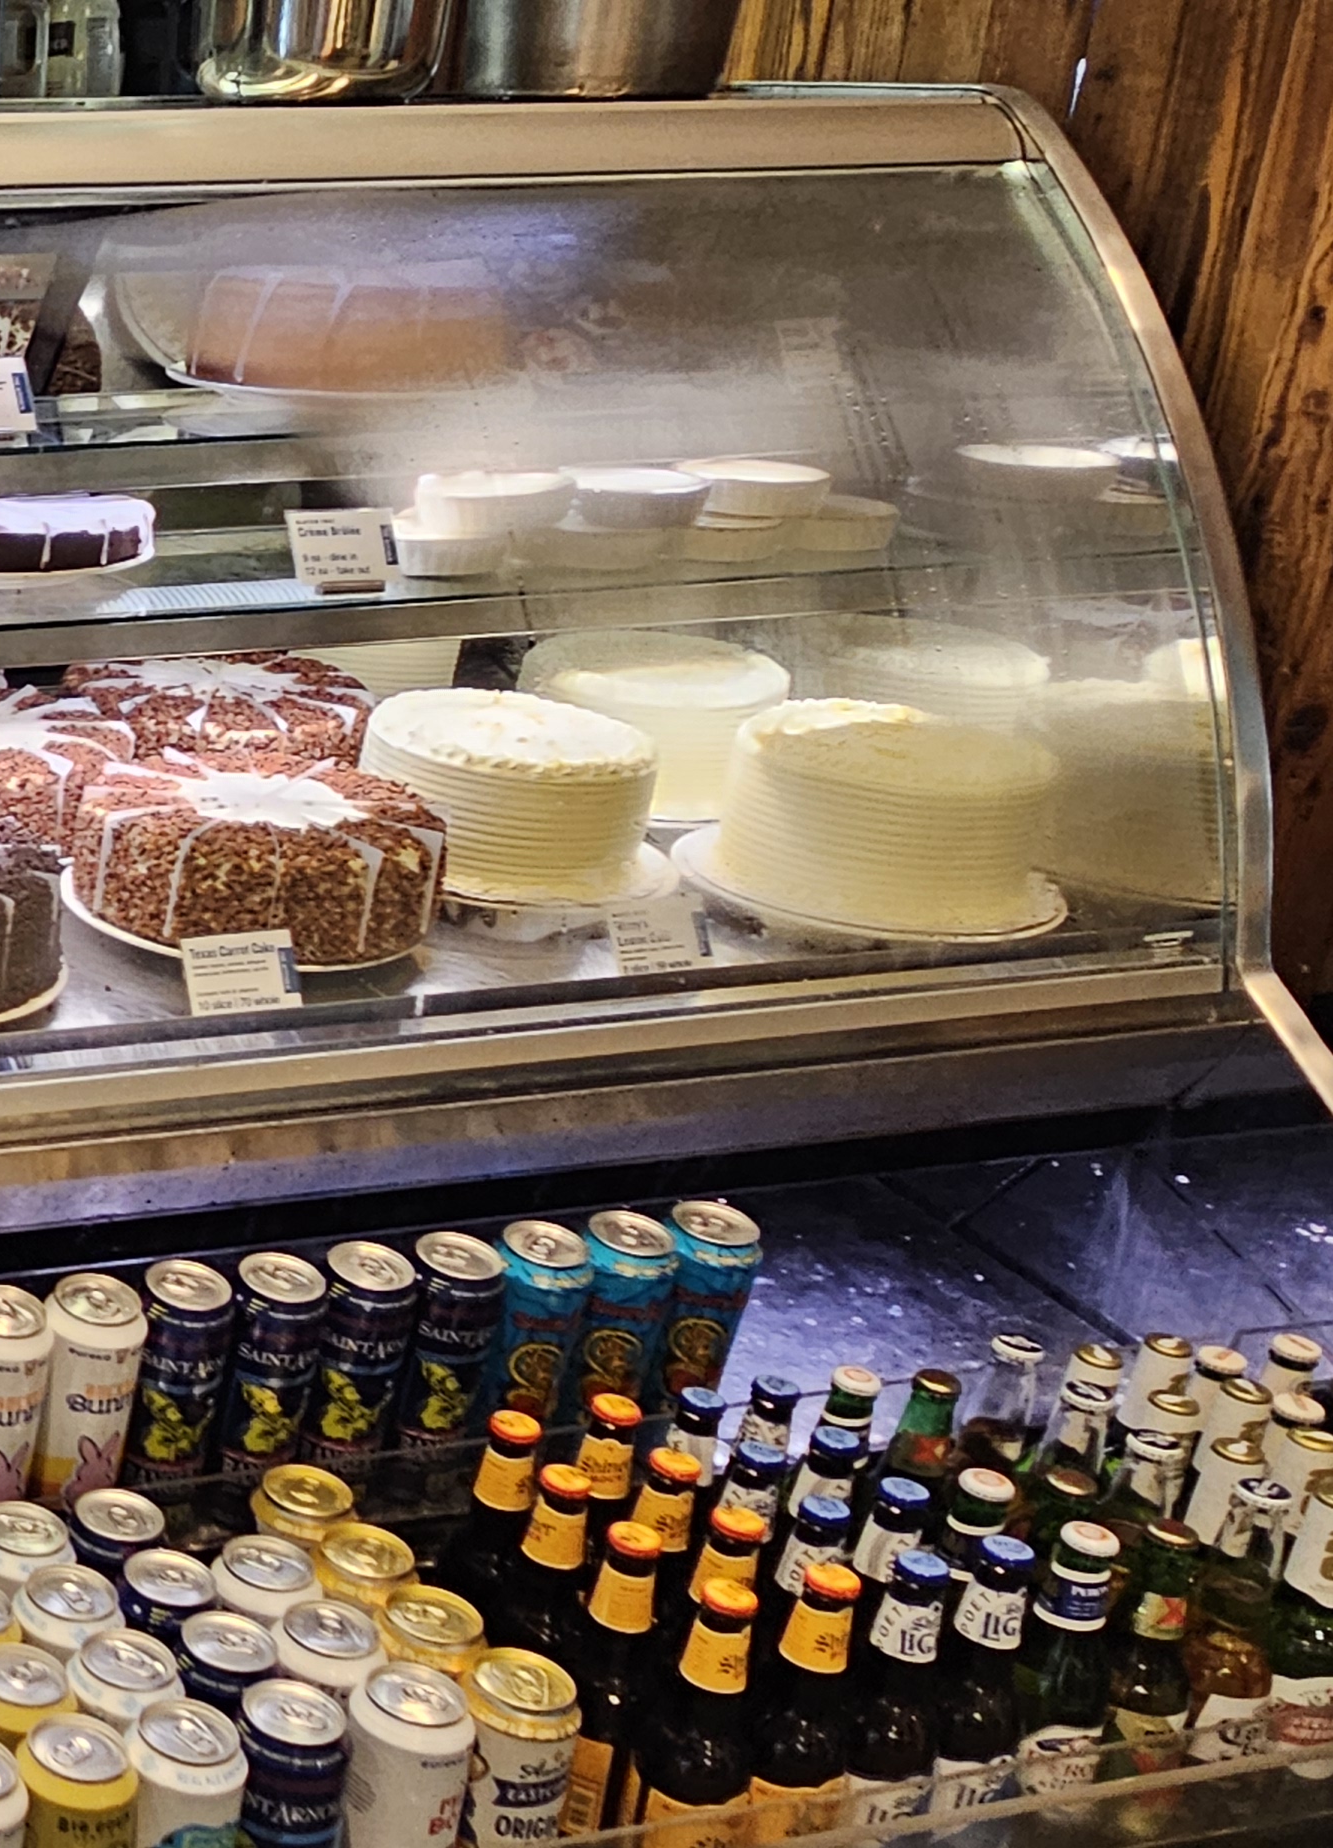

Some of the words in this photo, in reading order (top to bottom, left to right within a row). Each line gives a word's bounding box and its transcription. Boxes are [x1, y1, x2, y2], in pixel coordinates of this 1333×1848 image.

[189, 948, 217, 959] Texas
[219, 945, 248, 957] Carrot
[252, 942, 275, 954] Cake
[212, 999, 232, 1010] slice
[253, 996, 281, 1005] whole
[237, 1342, 294, 1371] SAINT
